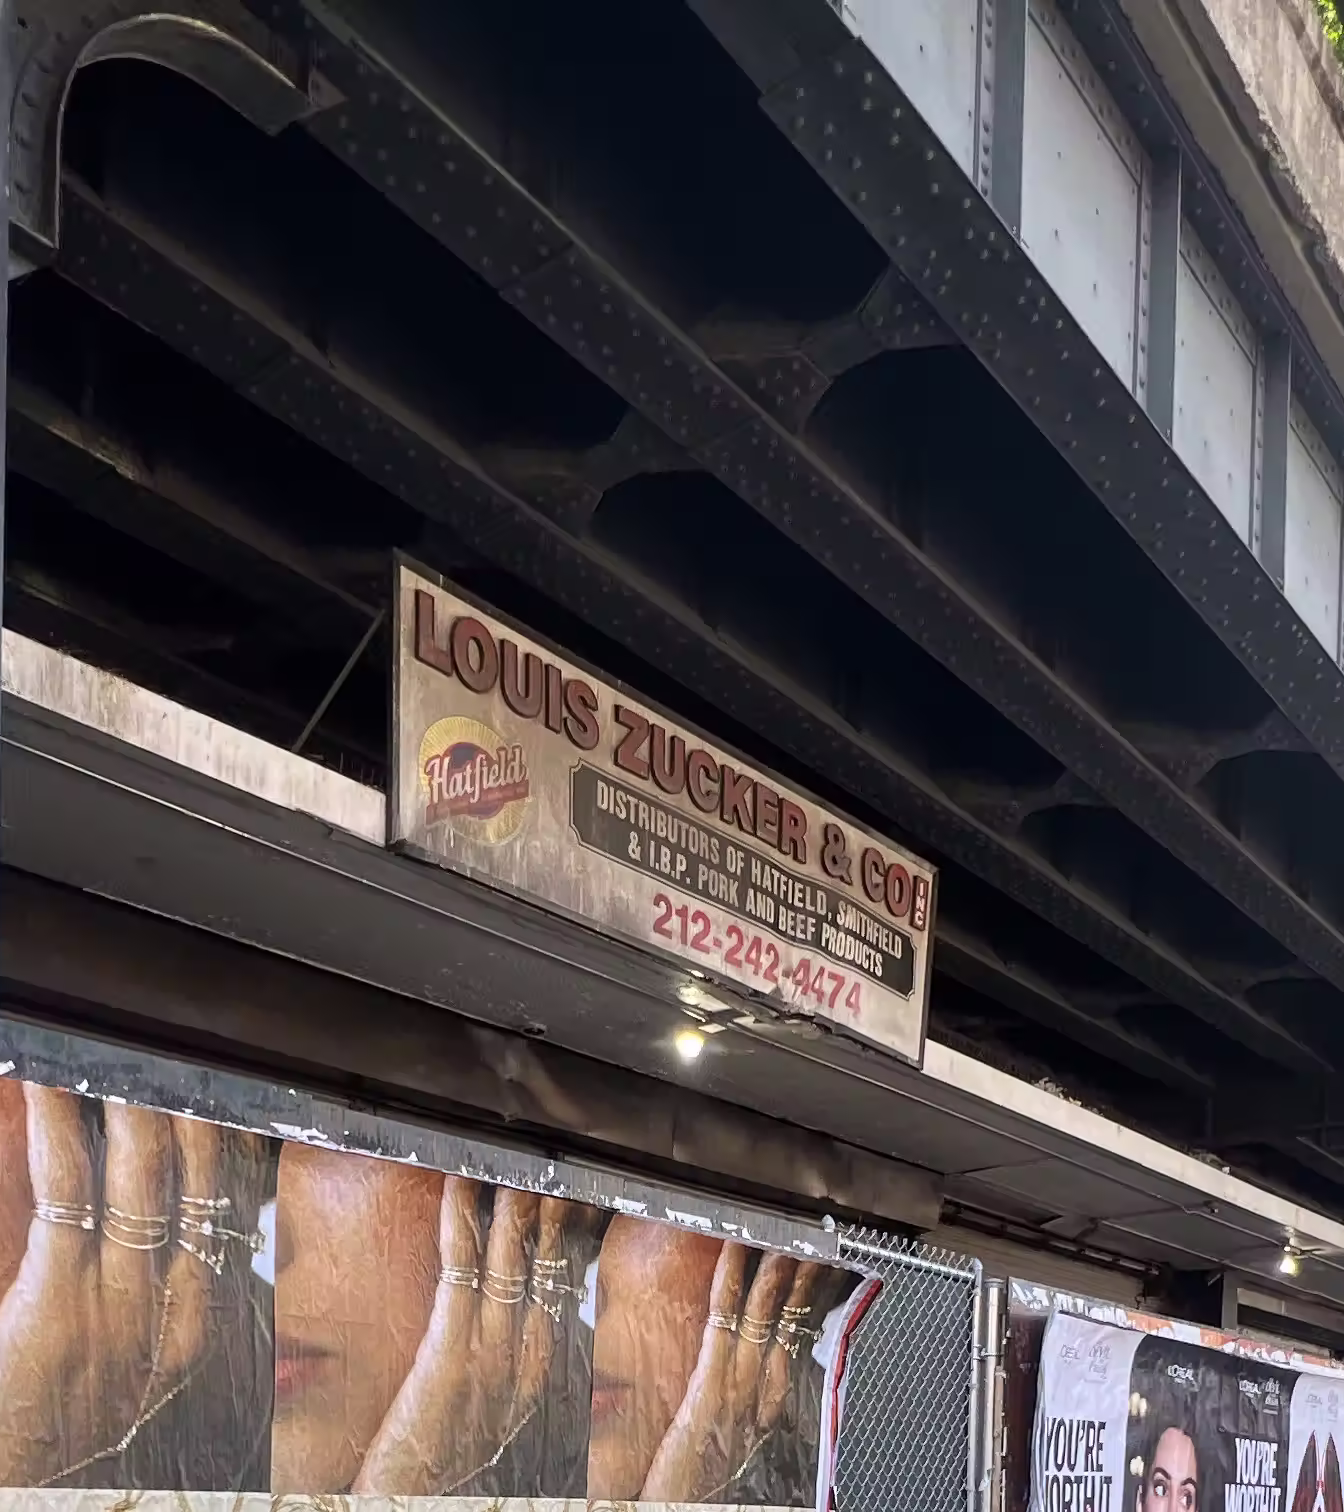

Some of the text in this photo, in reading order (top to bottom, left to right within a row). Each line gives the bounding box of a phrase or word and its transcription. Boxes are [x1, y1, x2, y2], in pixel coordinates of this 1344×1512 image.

[414, 589, 912, 918] LOUIS ZUCKER & CO
[424, 742, 529, 804] Hatfield
[596, 779, 721, 865] DISTRIBUTORS
[726, 845, 745, 876] OF
[751, 857, 833, 922] HATFIELD,
[836, 900, 903, 960] SMITHFIELD
[628, 831, 884, 978] & I.B.P. PORK AND BEEF PRODUCTS
[652, 893, 862, 1018] 212-242-4474
[1044, 1416, 1107, 1473] YOU'RE
[1235, 1437, 1279, 1487] YOU'RE
